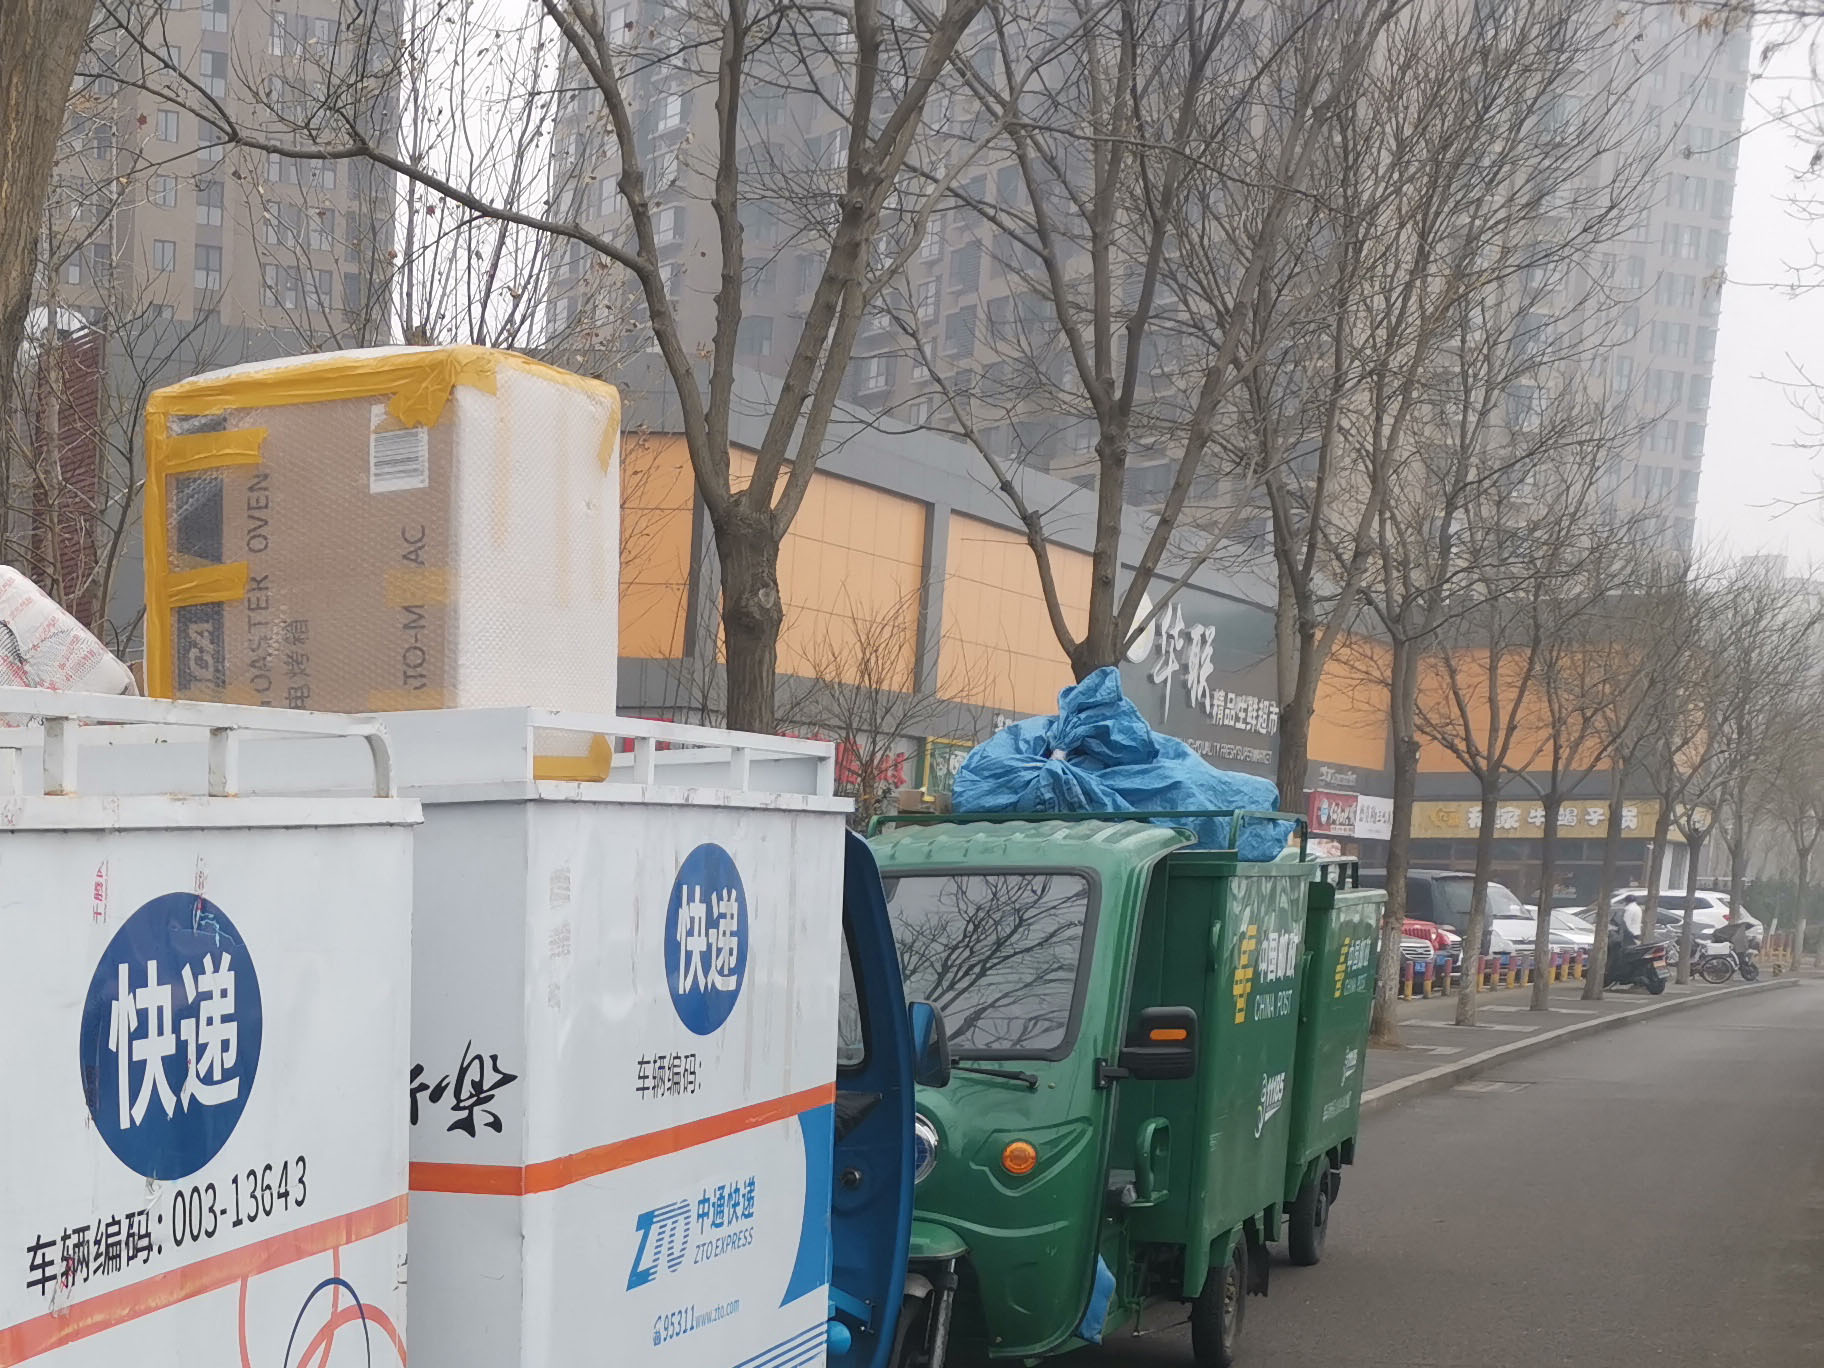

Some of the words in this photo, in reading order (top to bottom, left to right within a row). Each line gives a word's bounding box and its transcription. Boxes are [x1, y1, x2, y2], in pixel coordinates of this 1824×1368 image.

[247, 472, 271, 554] OVEN
[284, 618, 312, 710] 电烤箱
[676, 884, 739, 995] 快递
[108, 951, 240, 1130] 快递
[693, 1242, 713, 1265] ZTO
[713, 1226, 755, 1258] EXPRESS
[695, 1175, 756, 1236] 中通快递
[662, 1303, 695, 1343] 95311
